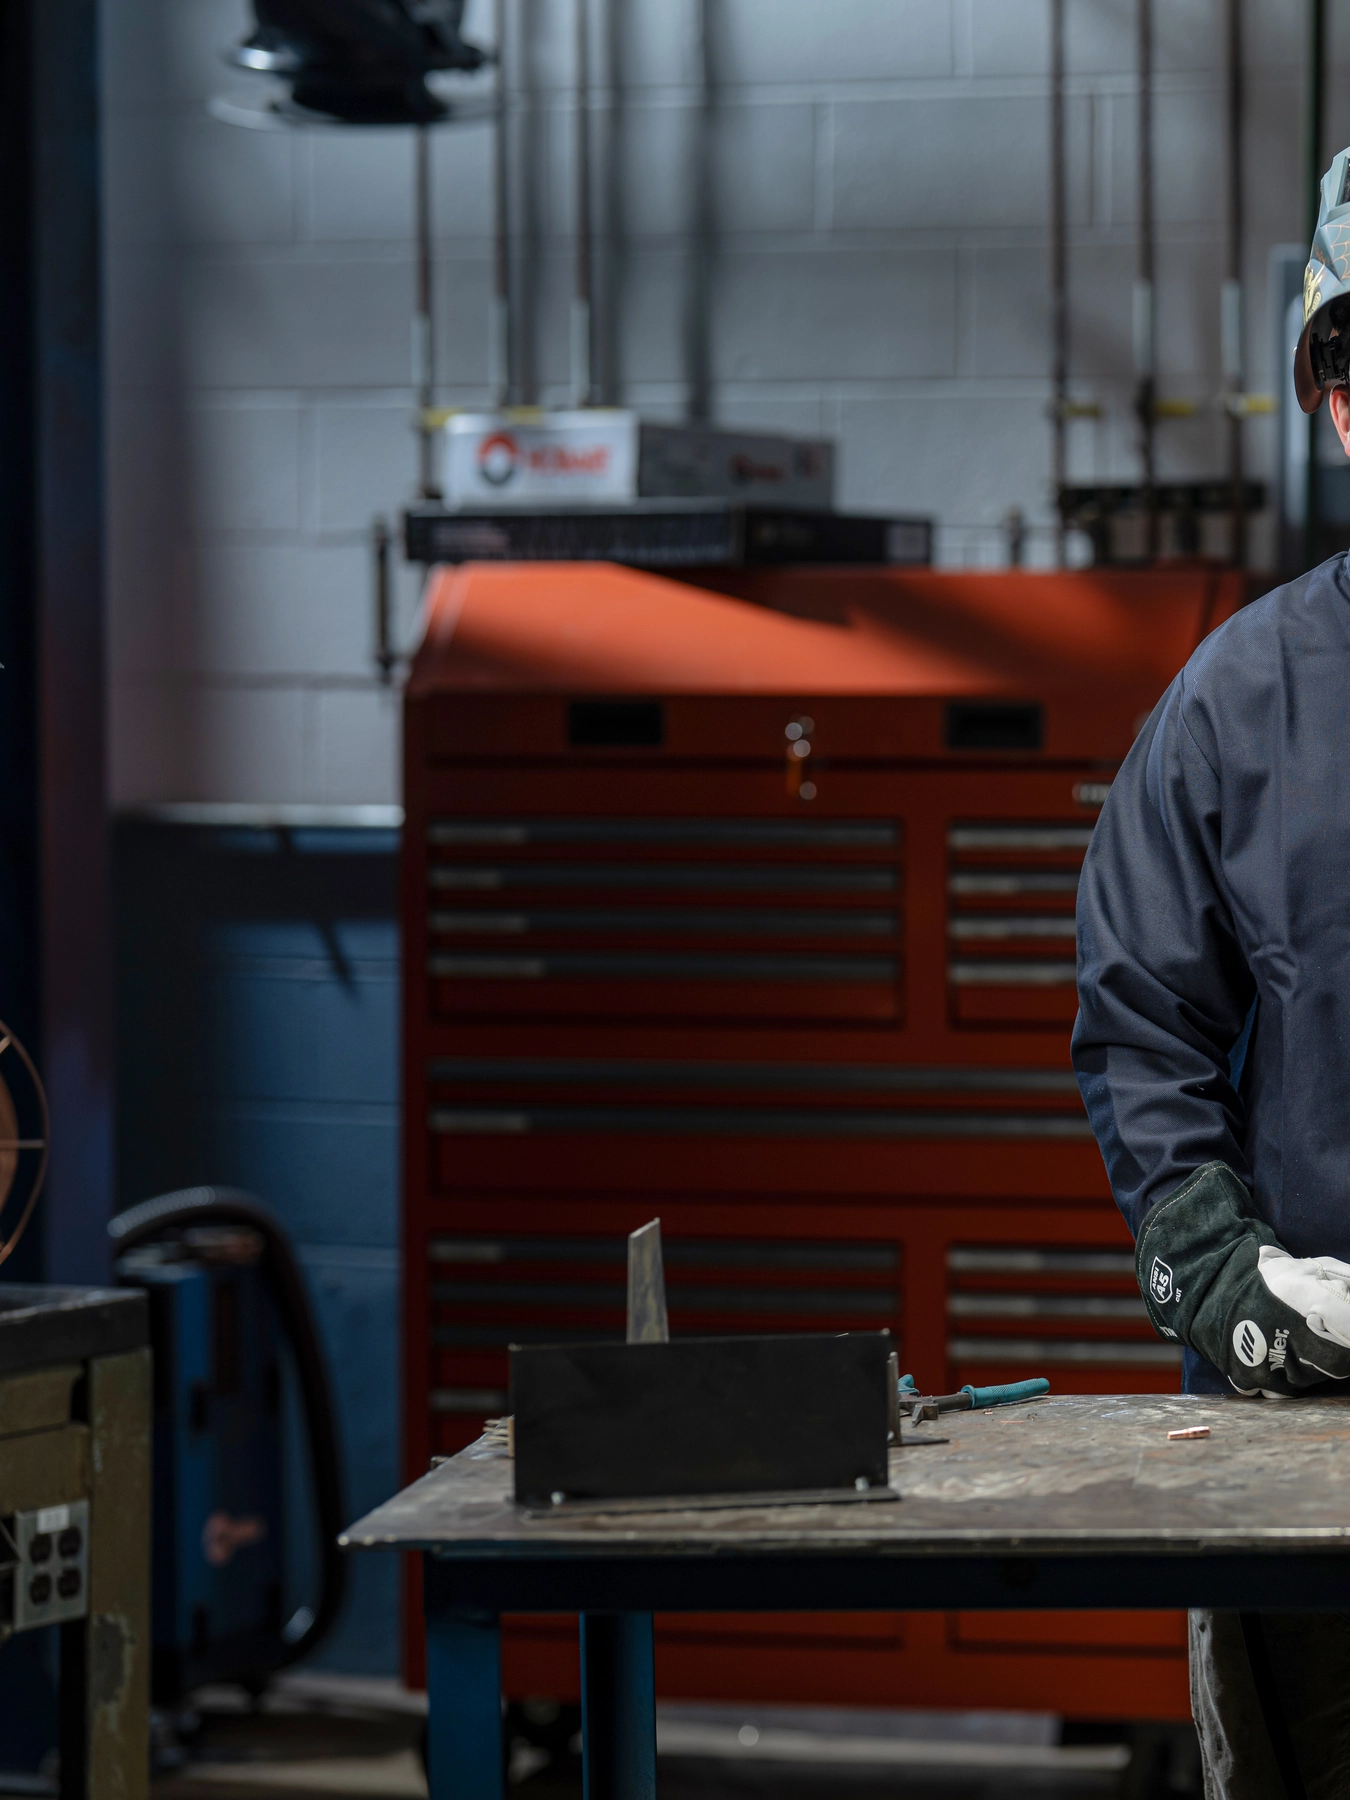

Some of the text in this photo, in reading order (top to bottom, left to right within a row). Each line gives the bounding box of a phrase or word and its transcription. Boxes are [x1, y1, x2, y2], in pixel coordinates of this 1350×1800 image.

[1151, 1266, 1160, 1291] ANSI
[1156, 1271, 1170, 1300] A5
[1175, 1287, 1183, 1303] CUT
